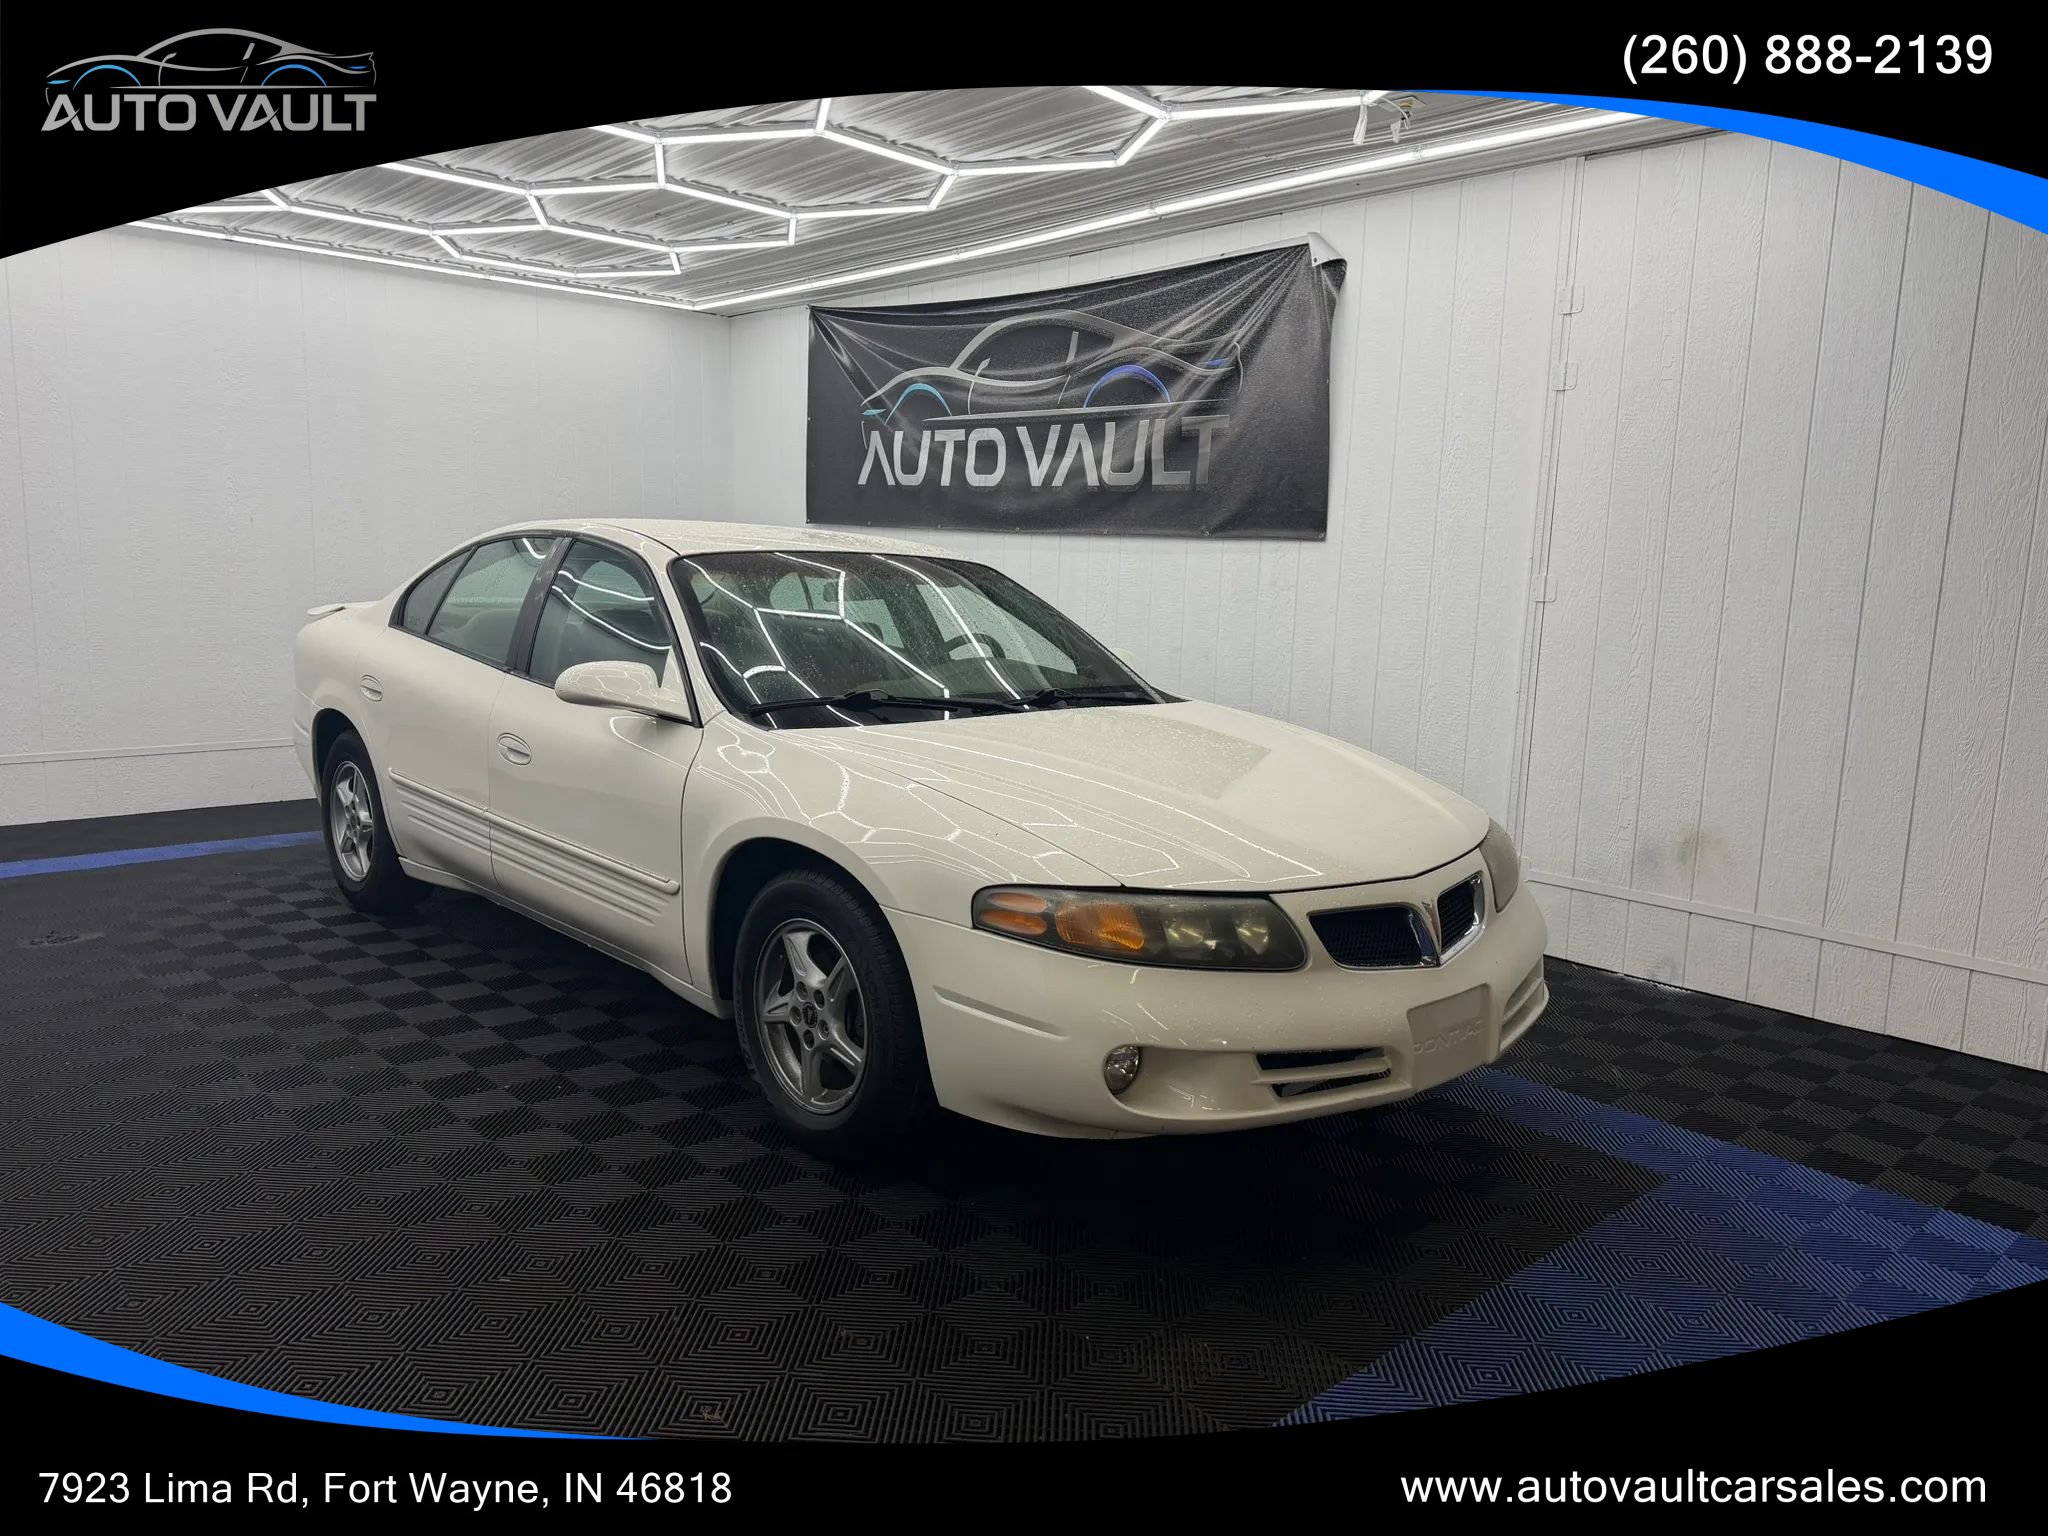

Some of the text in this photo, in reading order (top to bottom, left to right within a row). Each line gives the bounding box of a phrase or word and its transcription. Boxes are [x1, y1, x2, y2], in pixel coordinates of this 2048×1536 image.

[857, 414, 1231, 487] AUTO VAULT
[1413, 1019, 1484, 1055] PONTIAC
